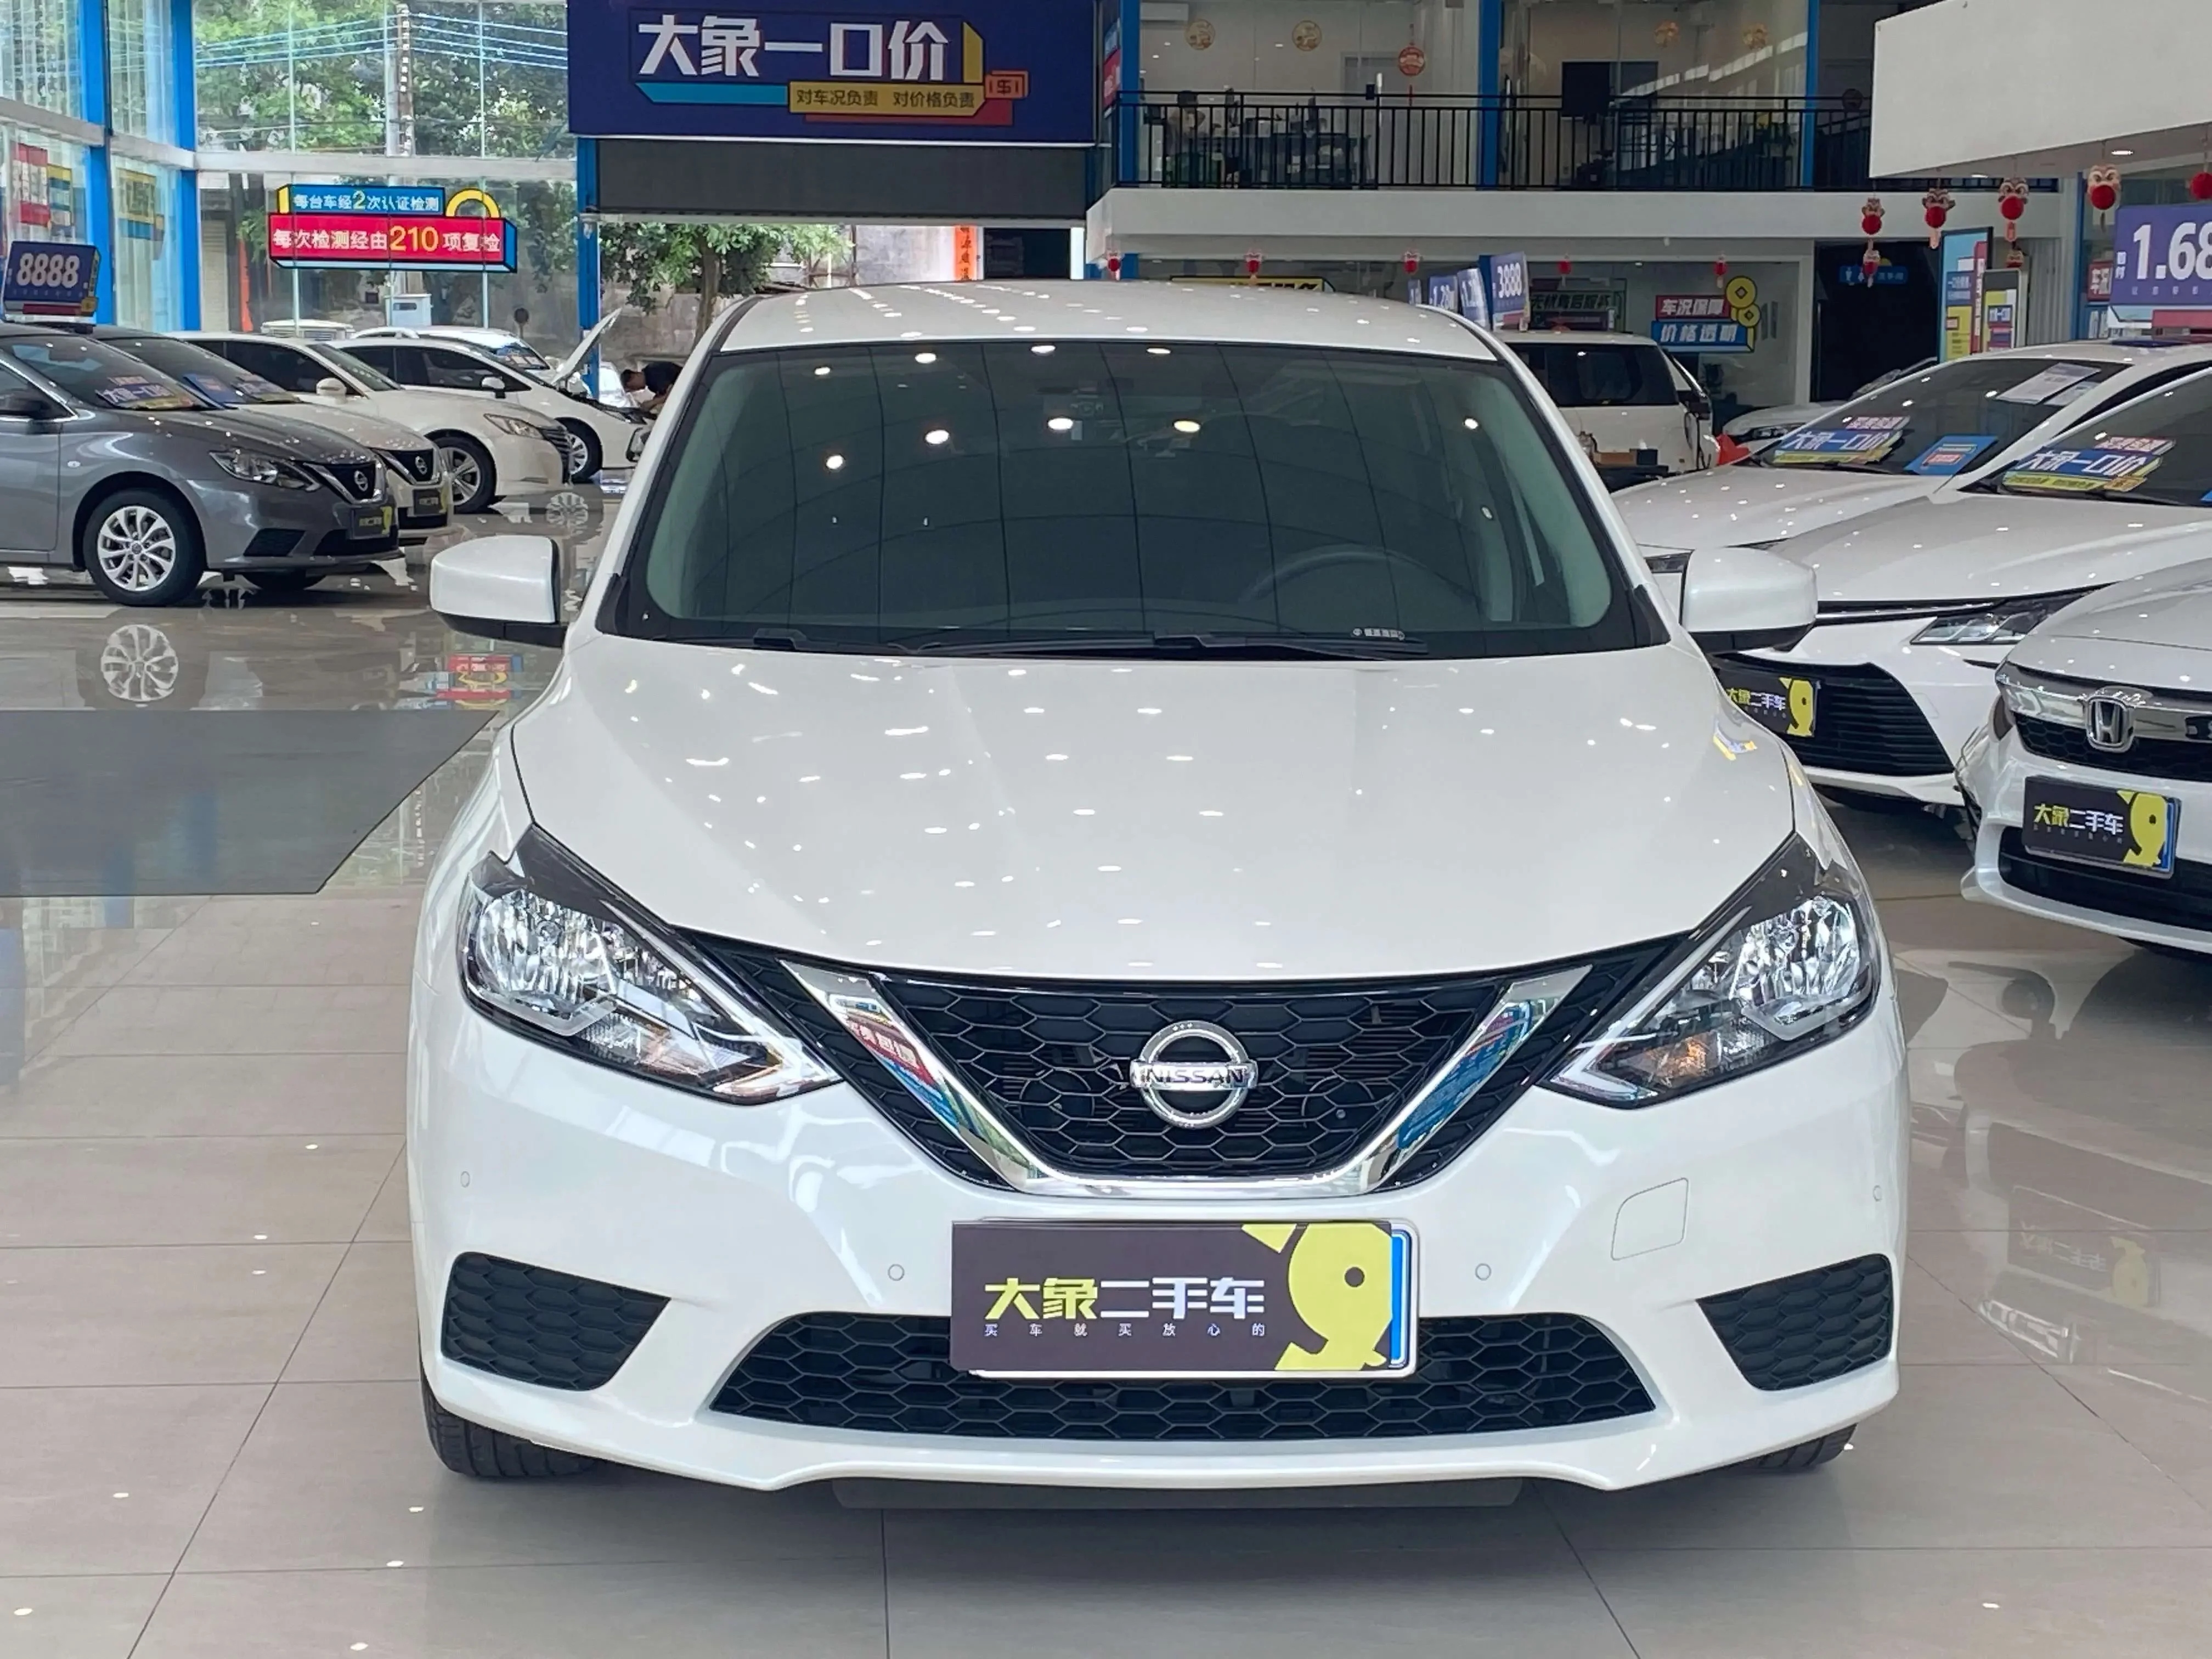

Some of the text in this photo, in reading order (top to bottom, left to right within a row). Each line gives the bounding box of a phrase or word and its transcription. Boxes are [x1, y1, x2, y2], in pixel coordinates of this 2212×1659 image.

[639, 14, 949, 81] 大象一口价
[797, 89, 975, 109] 对车况负责 对价格负责
[16, 253, 80, 289] 8888
[1497, 262, 1522, 298] 3888
[2033, 803, 2124, 835] 大象二手车
[1141, 1066, 1248, 1083] NISSAN
[985, 1277, 1265, 1319] 大象二手车
[985, 1323, 1265, 1336] 买车就买放心的
